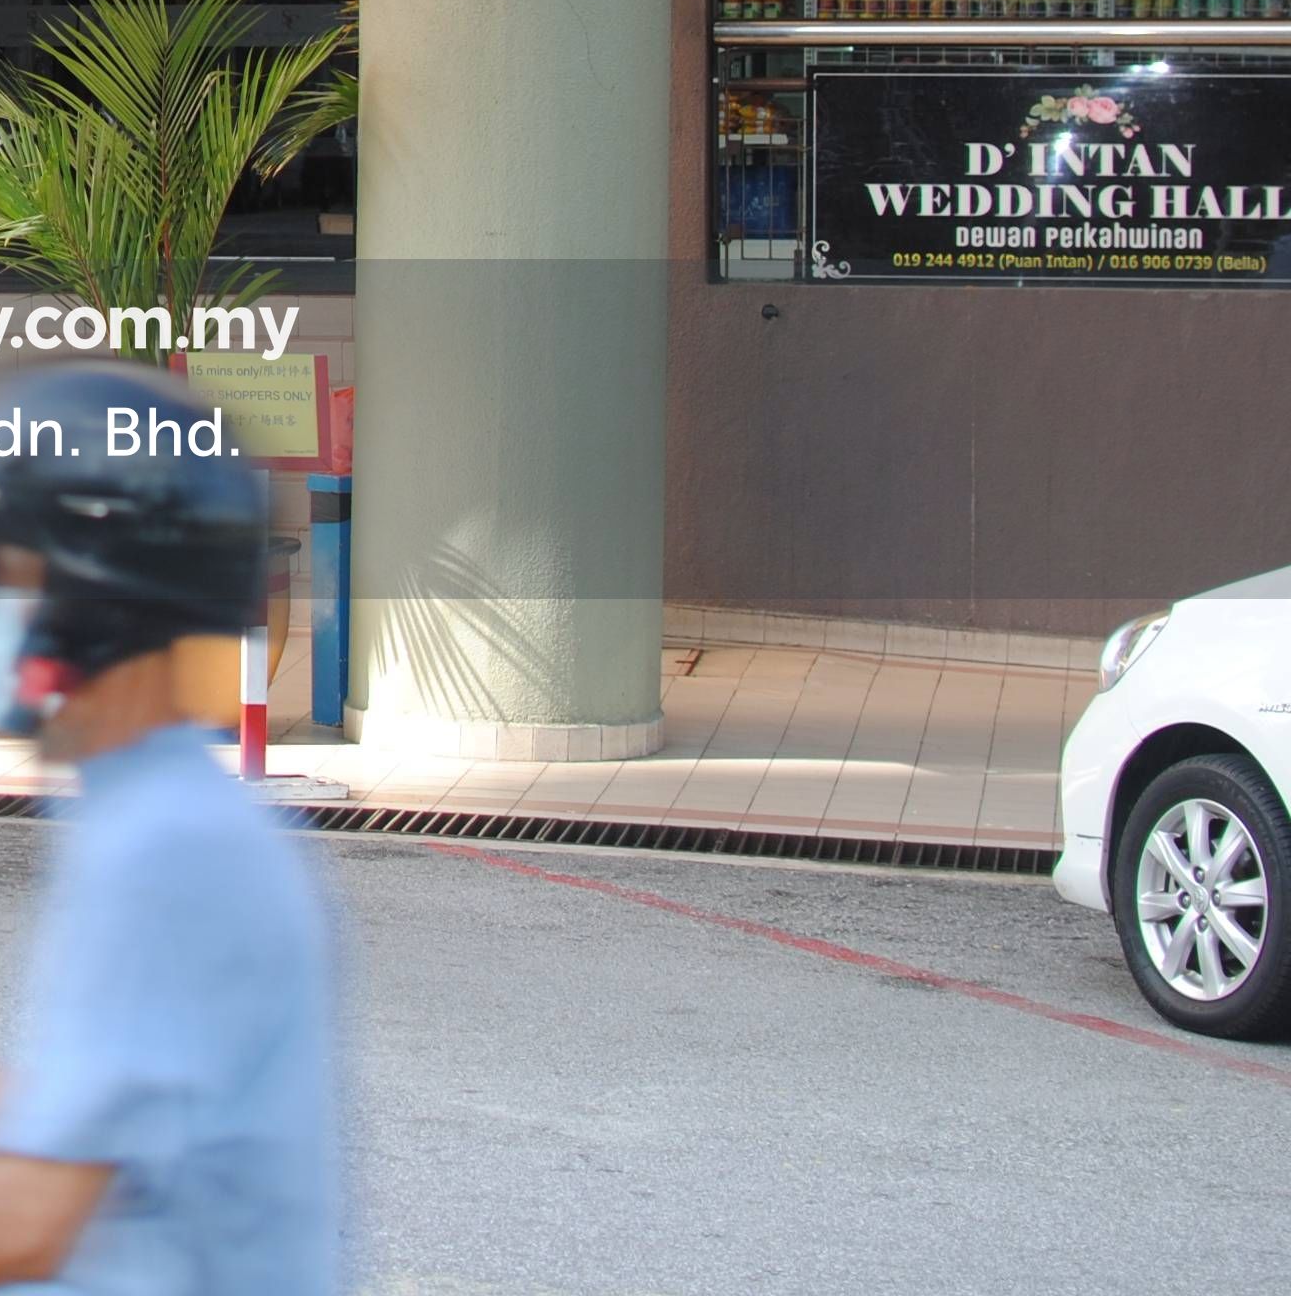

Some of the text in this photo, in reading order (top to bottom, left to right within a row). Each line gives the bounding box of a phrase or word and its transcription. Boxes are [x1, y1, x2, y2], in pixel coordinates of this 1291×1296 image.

[1028, 143, 1197, 178] INTAN
[864, 183, 1291, 220] WEDDING HALL
[893, 254, 921, 267] 019
[925, 254, 953, 267] 244
[957, 254, 995, 268] 4912
[998, 254, 1042, 271] (Puan
[1046, 254, 1094, 271] Intan)
[1109, 255, 1139, 269] 016
[1142, 255, 1171, 269] 906
[1175, 256, 1213, 270] 0739
[191, 365, 203, 377] 15
[206, 365, 233, 377] mins
[218, 390, 281, 401] SHOPPERS
[283, 390, 313, 401] ONLY
